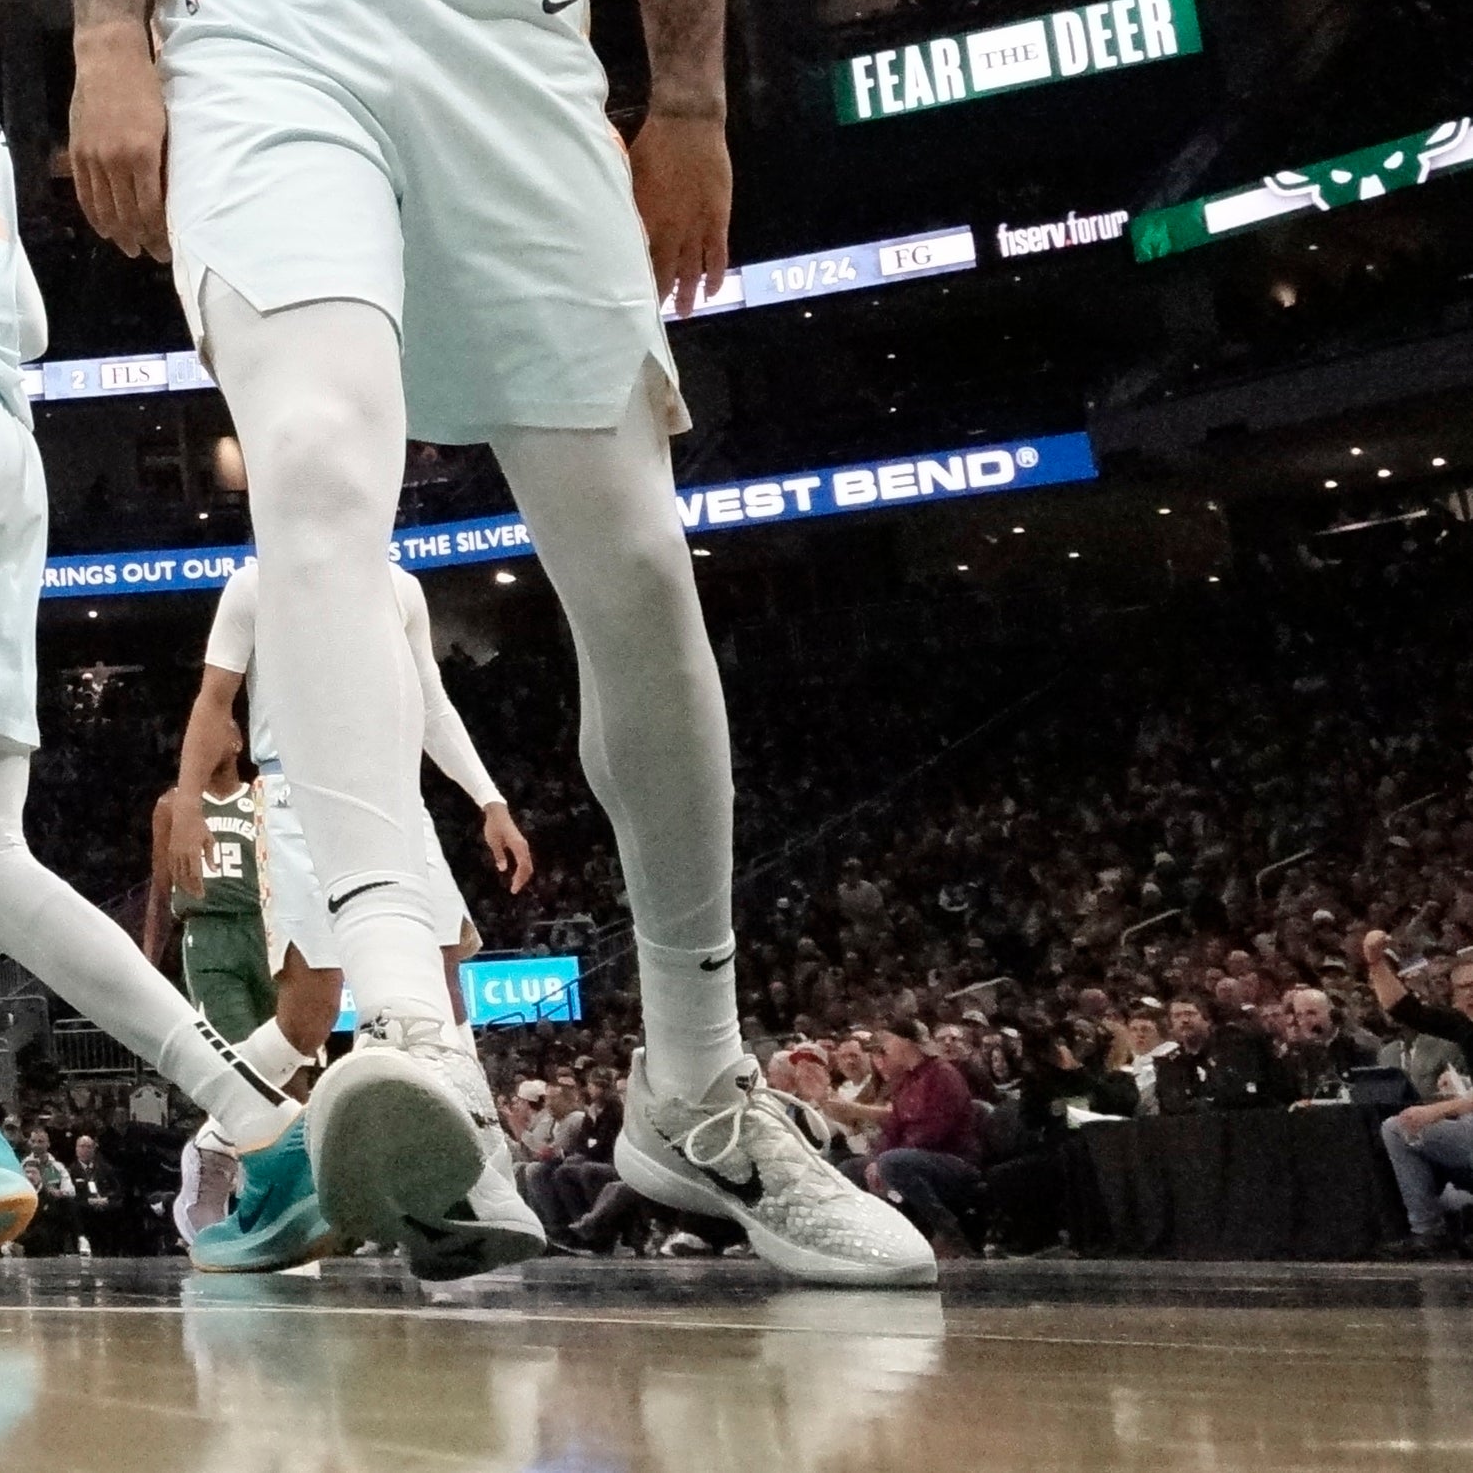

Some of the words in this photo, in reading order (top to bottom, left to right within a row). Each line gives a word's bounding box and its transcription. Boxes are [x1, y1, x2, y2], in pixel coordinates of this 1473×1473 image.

[851, 37, 967, 119] FEAR
[978, 42, 1039, 71] THE
[770, 255, 858, 295] 10/24
[894, 244, 934, 270] FG
[70, 370, 86, 391] 2
[111, 366, 151, 385] FLS
[122, 560, 177, 583] OUT
[182, 556, 241, 580] OUR
[403, 533, 452, 560] THE
[456, 523, 532, 554] SILVER
[481, 976, 564, 1006] CLUB
